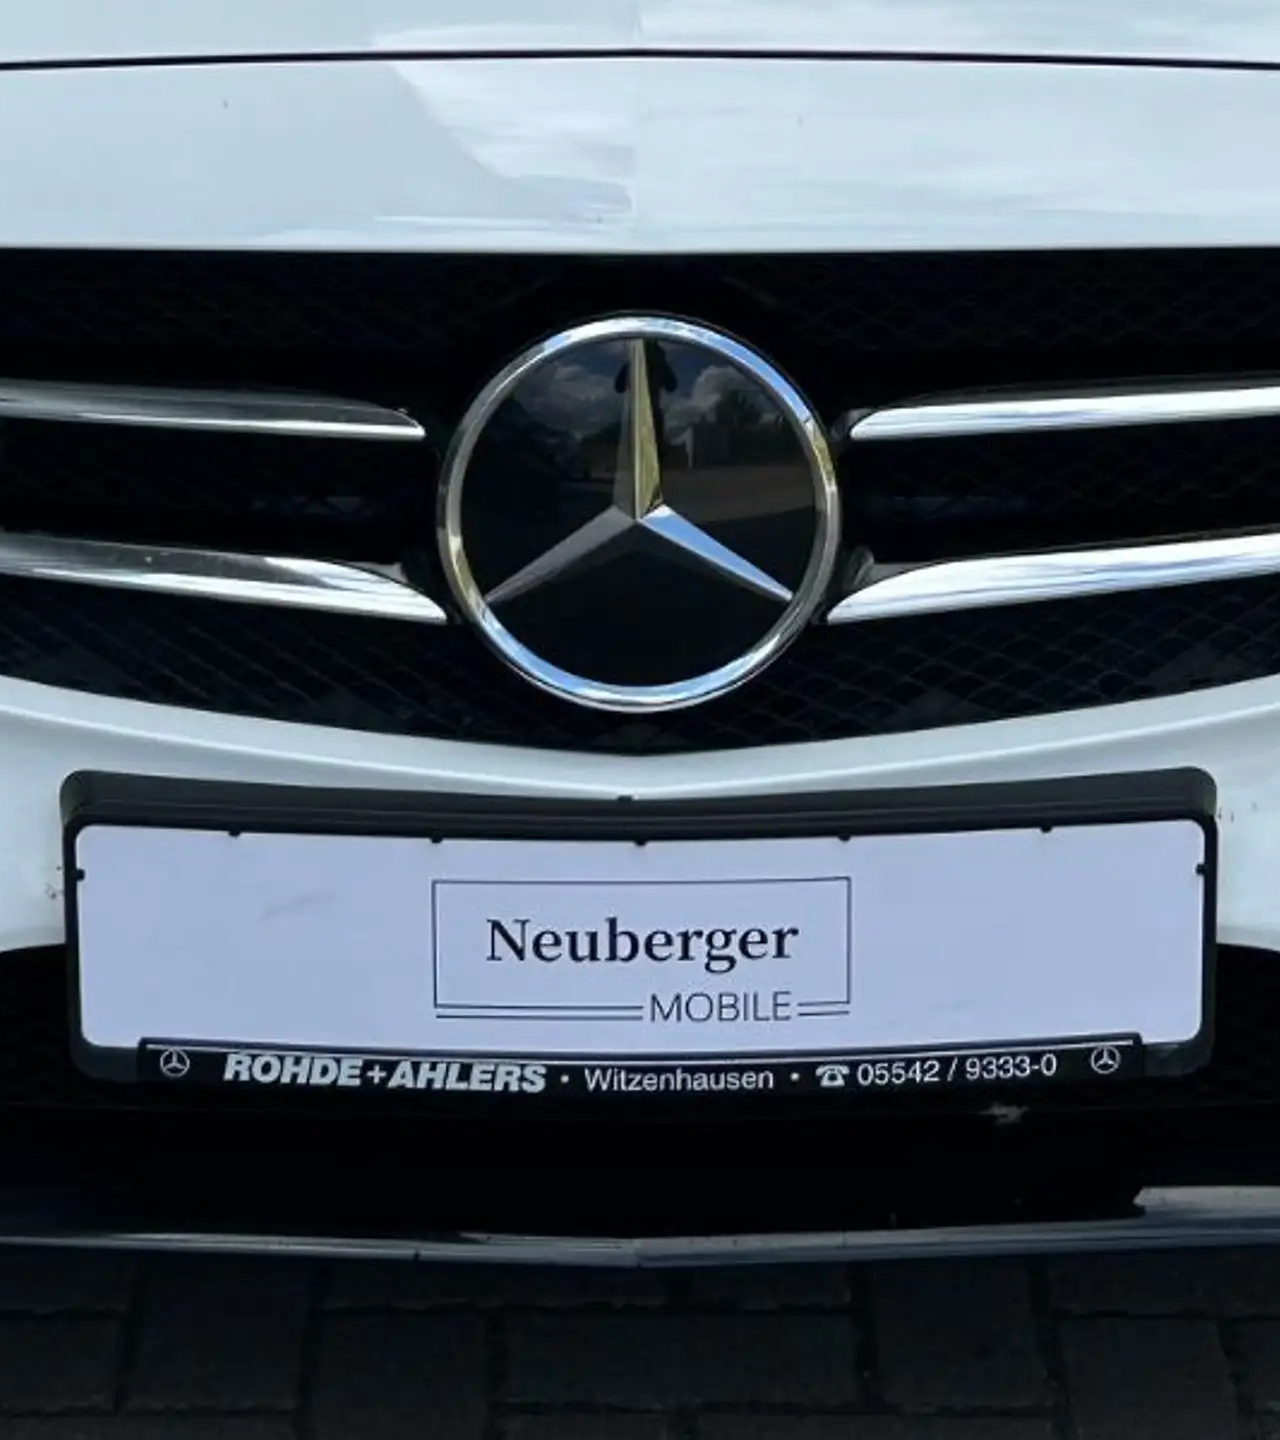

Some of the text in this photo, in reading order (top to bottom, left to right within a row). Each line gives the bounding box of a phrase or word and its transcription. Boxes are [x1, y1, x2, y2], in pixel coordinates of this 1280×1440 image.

[485, 917, 799, 974] Neuberger
[650, 991, 792, 1022] MOBILE
[223, 1054, 546, 1092] ROHDE+AHLERS
[584, 1068, 774, 1092] Witzenhausen
[857, 1062, 940, 1085] 05542
[964, 1053, 1057, 1081] 9333-0
